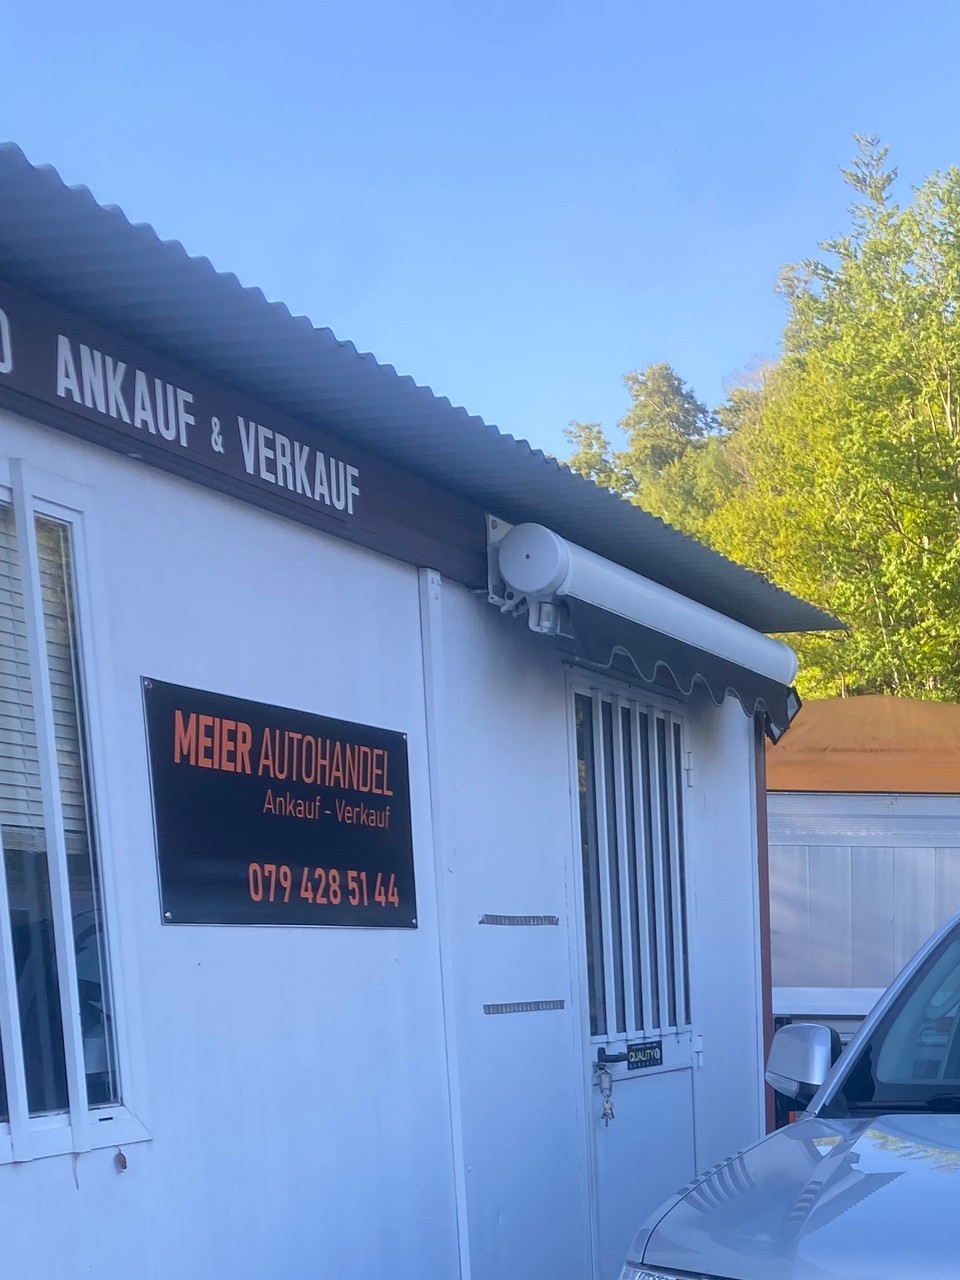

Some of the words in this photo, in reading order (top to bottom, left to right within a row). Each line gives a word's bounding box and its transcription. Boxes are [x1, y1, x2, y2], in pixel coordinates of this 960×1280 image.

[57, 334, 195, 447] ANKAUF
[211, 416, 224, 454] &
[237, 415, 360, 515] VERKAUF
[174, 709, 251, 774] MEIER
[258, 727, 393, 796] AUTOHANDEL
[263, 789, 321, 820] Ankauf
[336, 798, 391, 828] Verkauf
[249, 862, 292, 903] 079
[300, 866, 341, 905] 428
[347, 870, 368, 906] 51
[374, 872, 400, 908] 44
